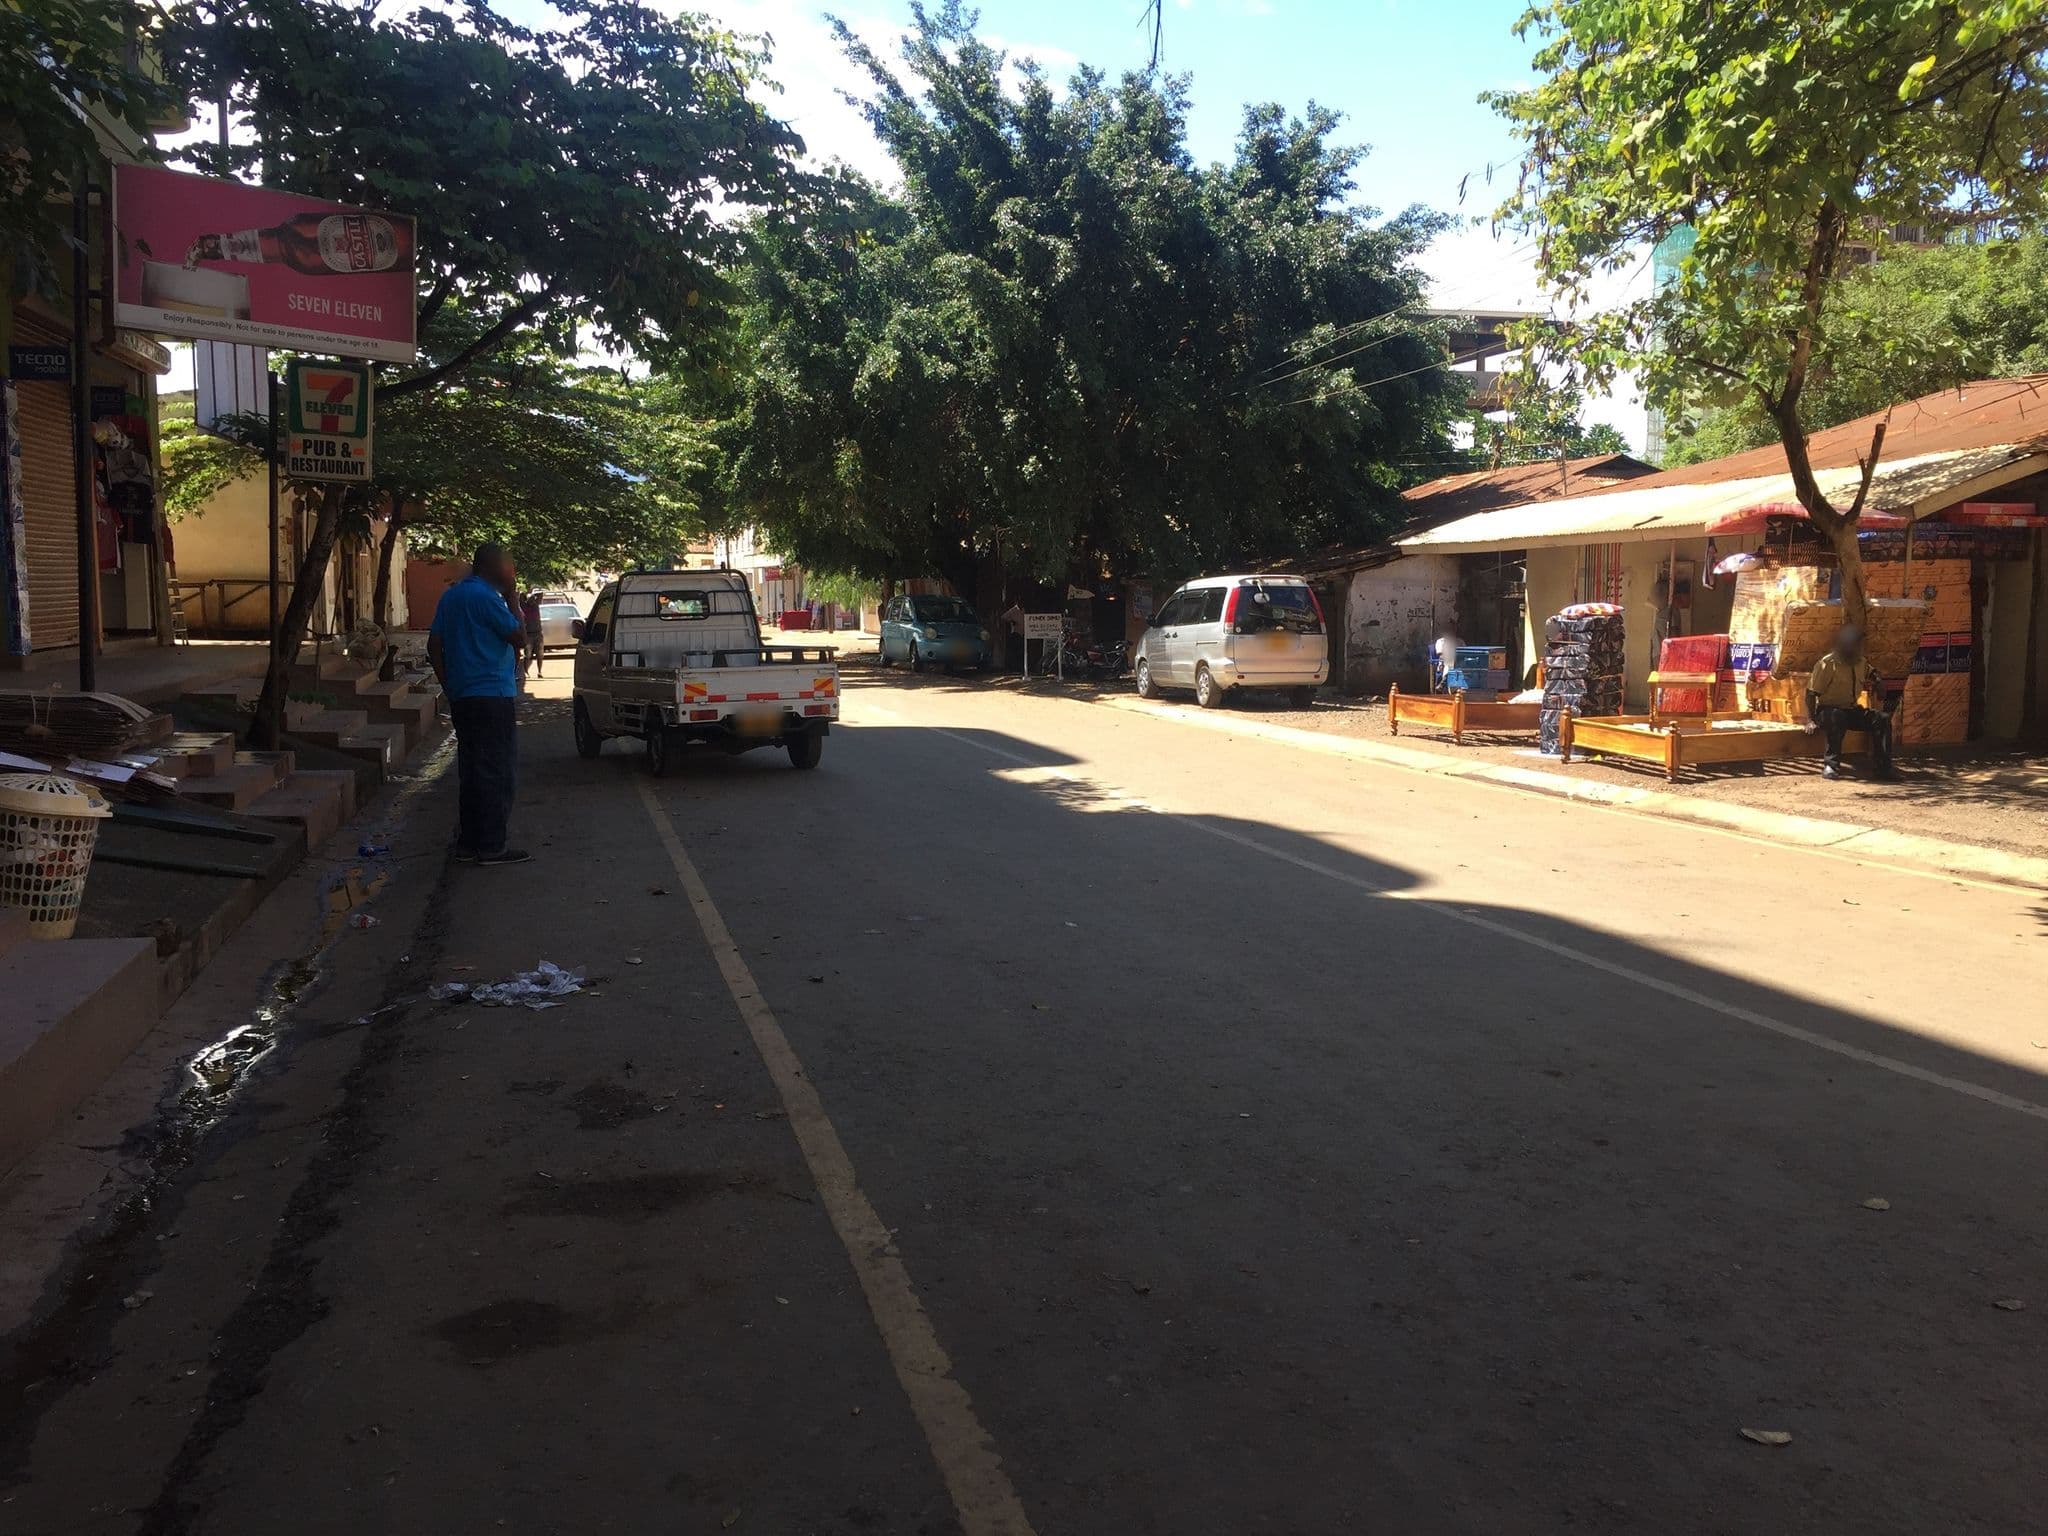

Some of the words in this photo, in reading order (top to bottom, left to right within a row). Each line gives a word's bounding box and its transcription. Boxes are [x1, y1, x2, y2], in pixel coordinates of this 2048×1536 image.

[348, 216, 367, 269] CASTLE
[288, 293, 330, 315] SEVEN
[335, 300, 382, 322] ELEVEN
[163, 313, 185, 324] Enjoy
[236, 323, 249, 331] Not
[250, 325, 261, 333] for
[262, 327, 277, 335] sale
[278, 329, 286, 337] to
[286, 331, 314, 340] persons
[315, 334, 336, 343] under
[349, 339, 361, 348] age
[15, 353, 66, 366] TECNO
[302, 438, 337, 457] PUB
[341, 442, 353, 458] &
[291, 457, 366, 476] RESTAURANT
